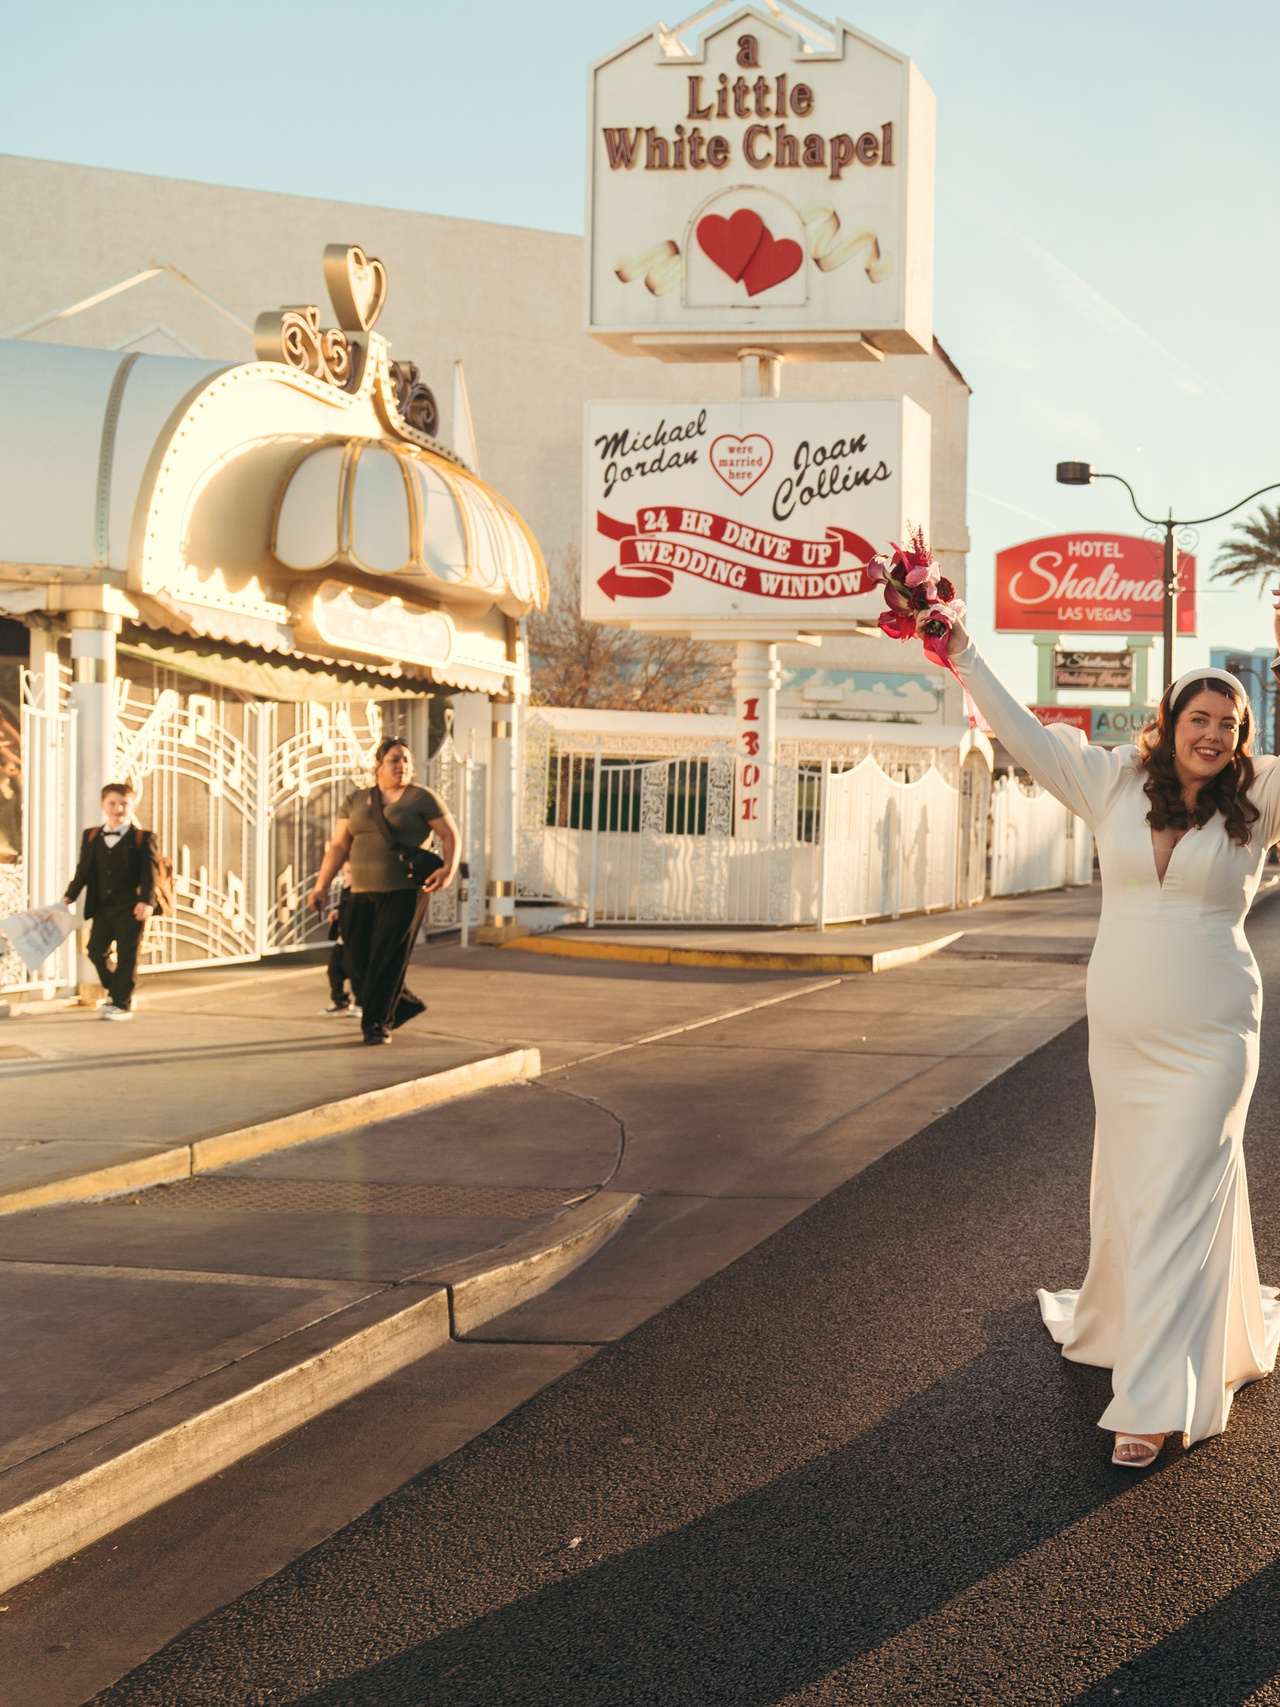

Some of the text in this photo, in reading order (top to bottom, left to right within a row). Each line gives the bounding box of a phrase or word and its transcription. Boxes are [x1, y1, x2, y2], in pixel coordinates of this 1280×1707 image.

[736, 34, 761, 69] a
[686, 73, 814, 121] Little
[602, 121, 895, 181] White Chapel
[595, 408, 706, 460] Michael
[728, 446, 753, 454] were
[604, 450, 698, 498] Jordan
[719, 457, 763, 467] married
[728, 469, 753, 480] here
[793, 433, 868, 487] Joan
[772, 460, 892, 522] Collins
[643, 510, 833, 566] 24 HR DRIVE UP
[1067, 540, 1124, 559] HOTEL
[634, 541, 863, 598] WEDDING WINDOW
[1008, 551, 1165, 604] Shalima
[1057, 606, 1132, 622] LAS VEGAS
[742, 698, 760, 820] 1301
